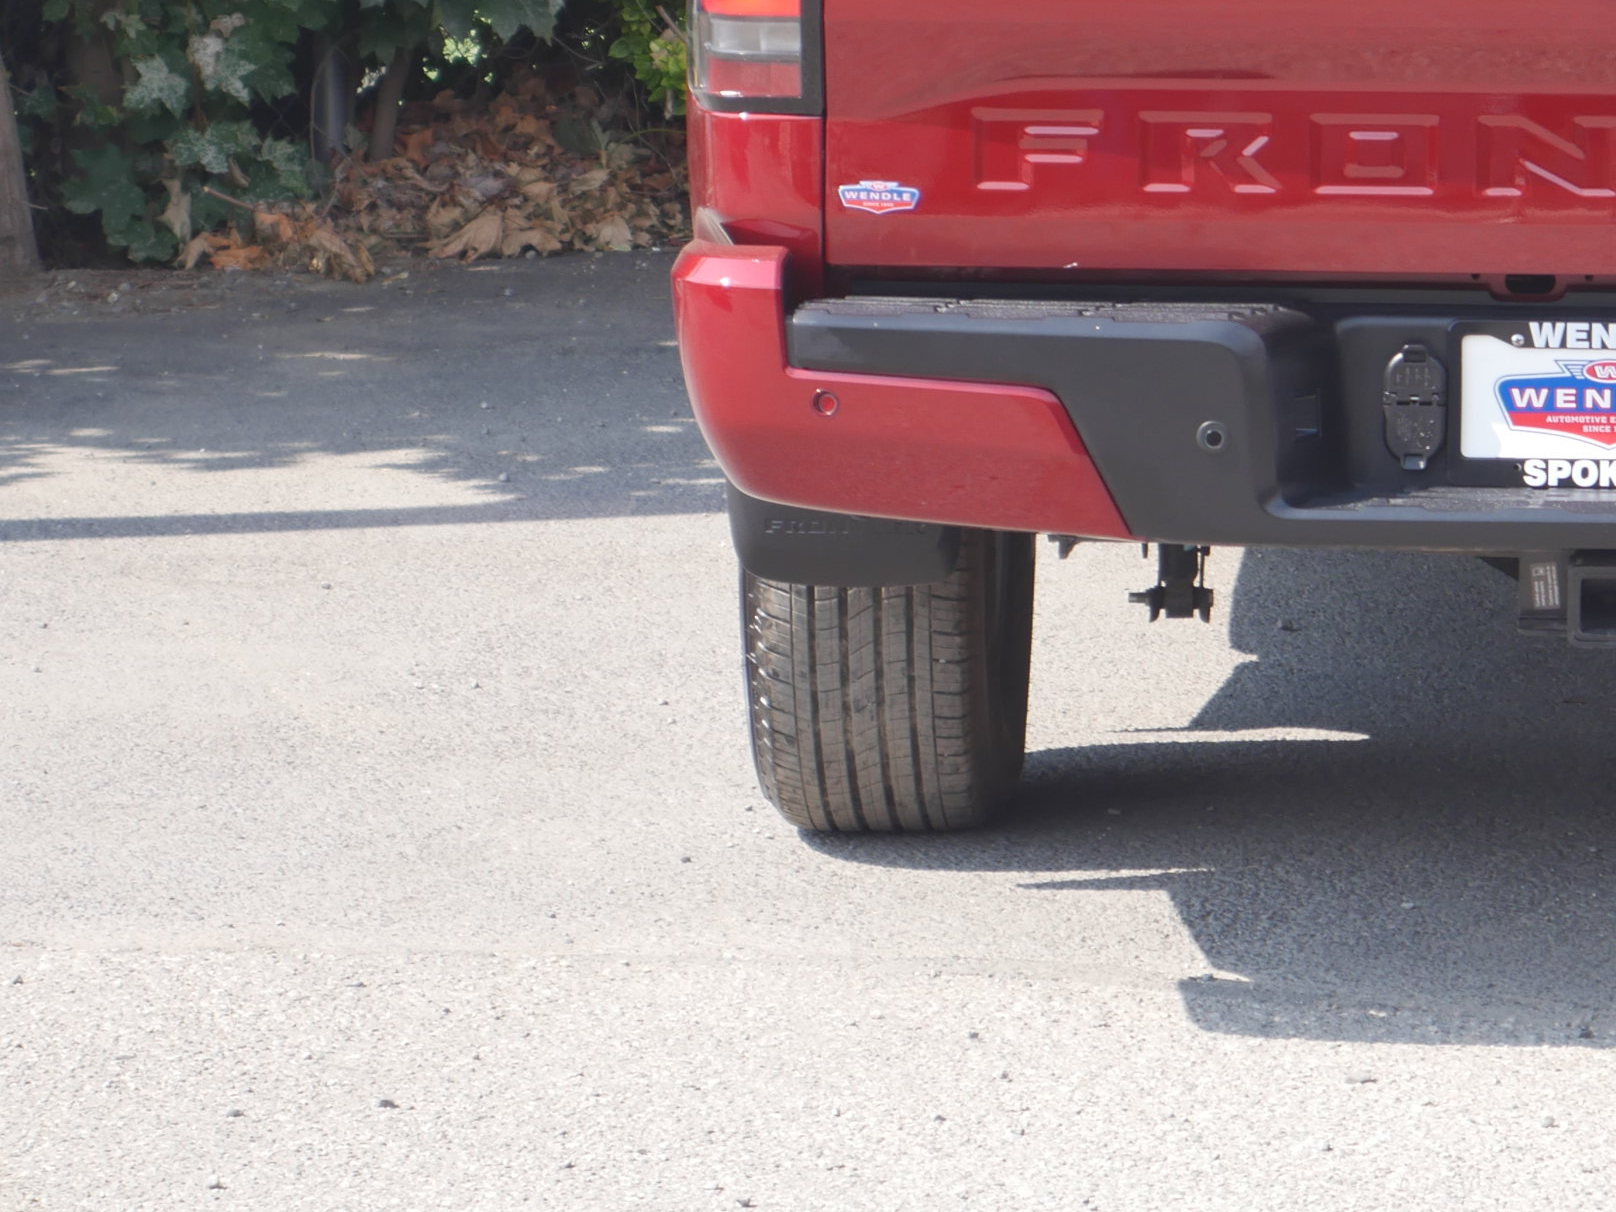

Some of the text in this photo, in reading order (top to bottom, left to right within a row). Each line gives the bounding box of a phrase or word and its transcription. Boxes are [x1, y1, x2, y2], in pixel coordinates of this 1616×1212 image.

[845, 191, 911, 201] WENDLE
[1546, 415, 1607, 423] AUTOMOTIVE
[1582, 425, 1610, 433] SINCE
